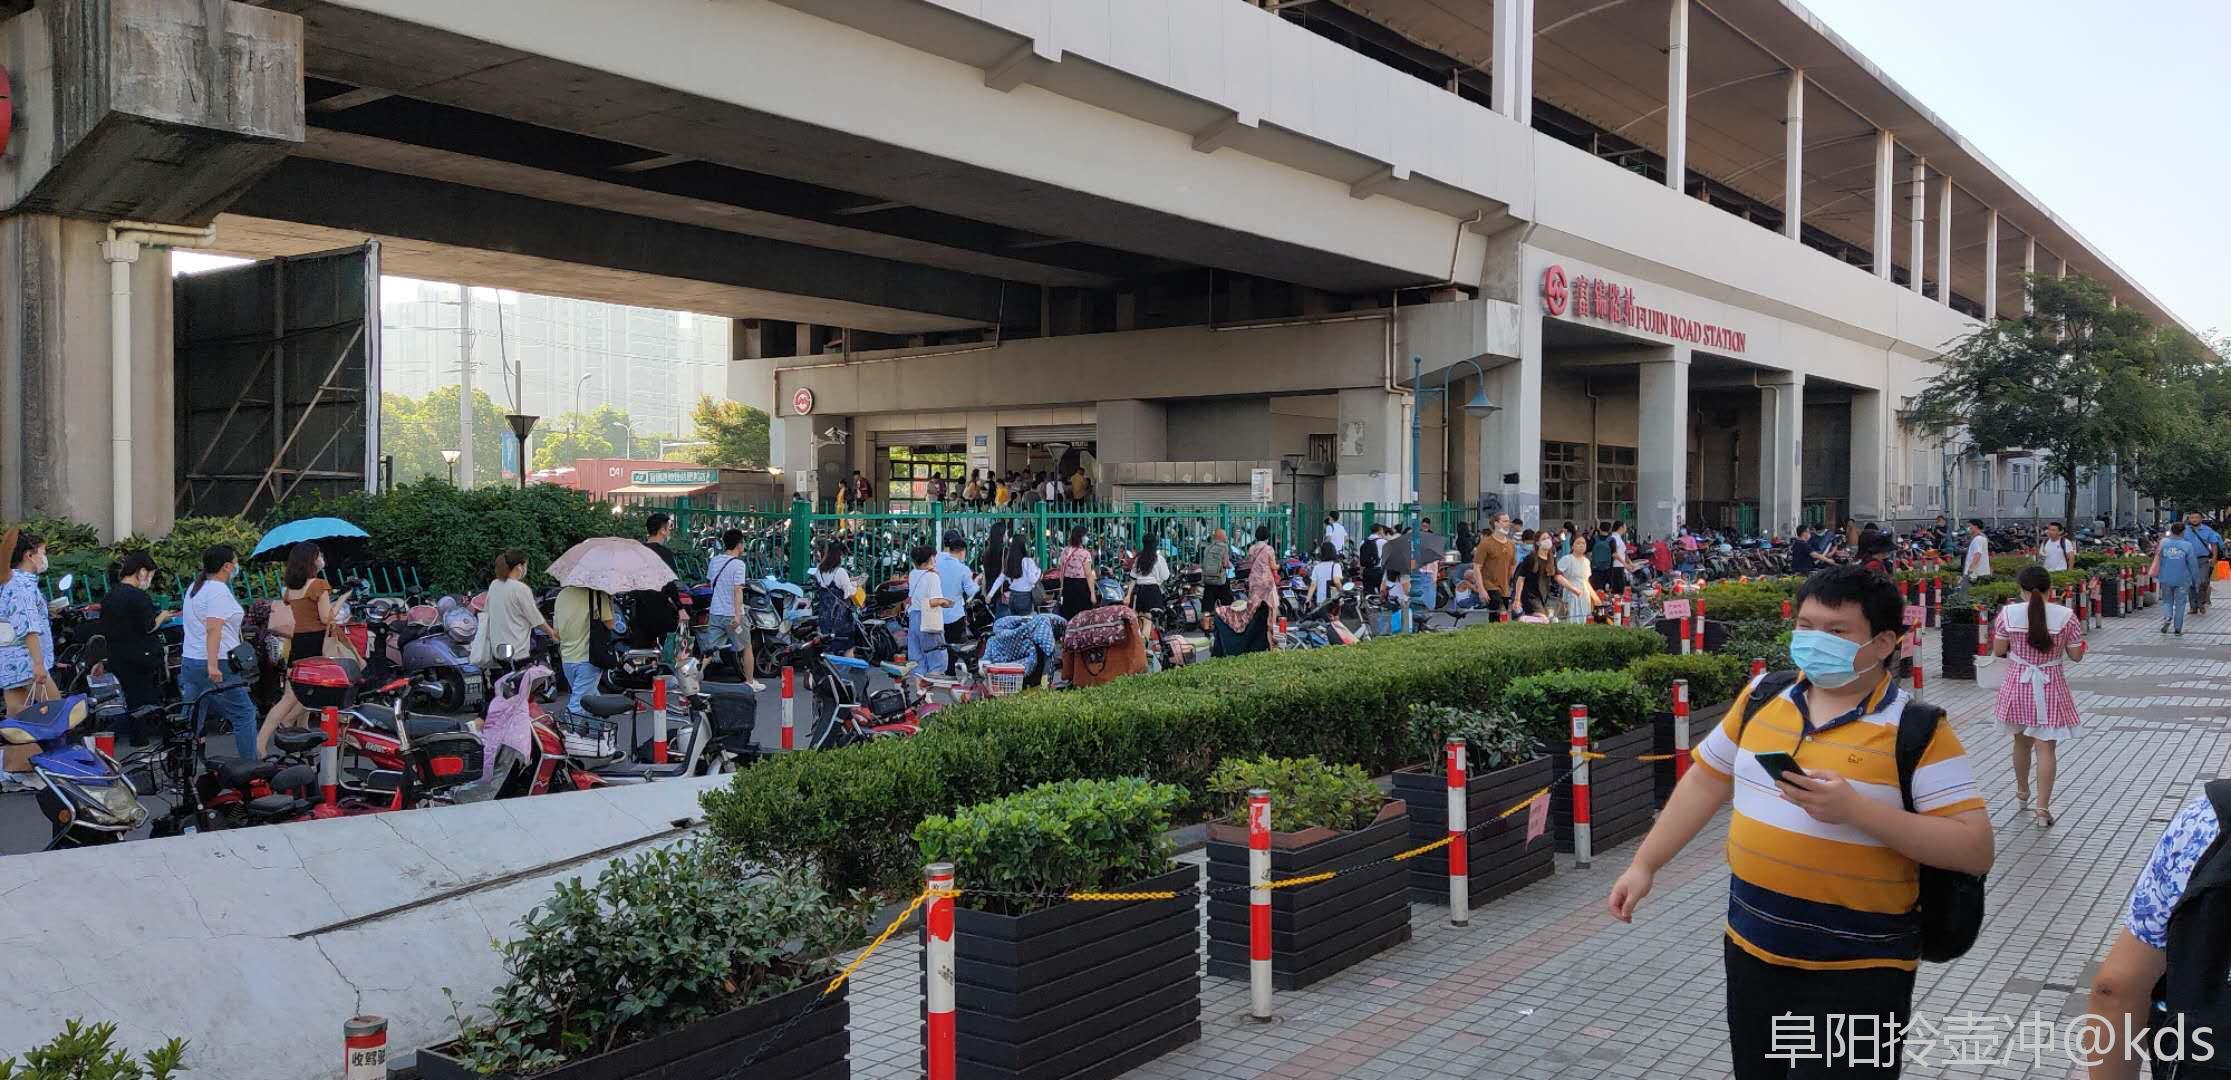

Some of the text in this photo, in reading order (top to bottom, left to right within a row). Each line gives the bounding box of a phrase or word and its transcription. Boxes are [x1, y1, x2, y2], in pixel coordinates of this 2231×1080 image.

[1574, 274, 1636, 328] 富锦路站
[1636, 305, 1746, 353] FUJIN ROAD STATION
